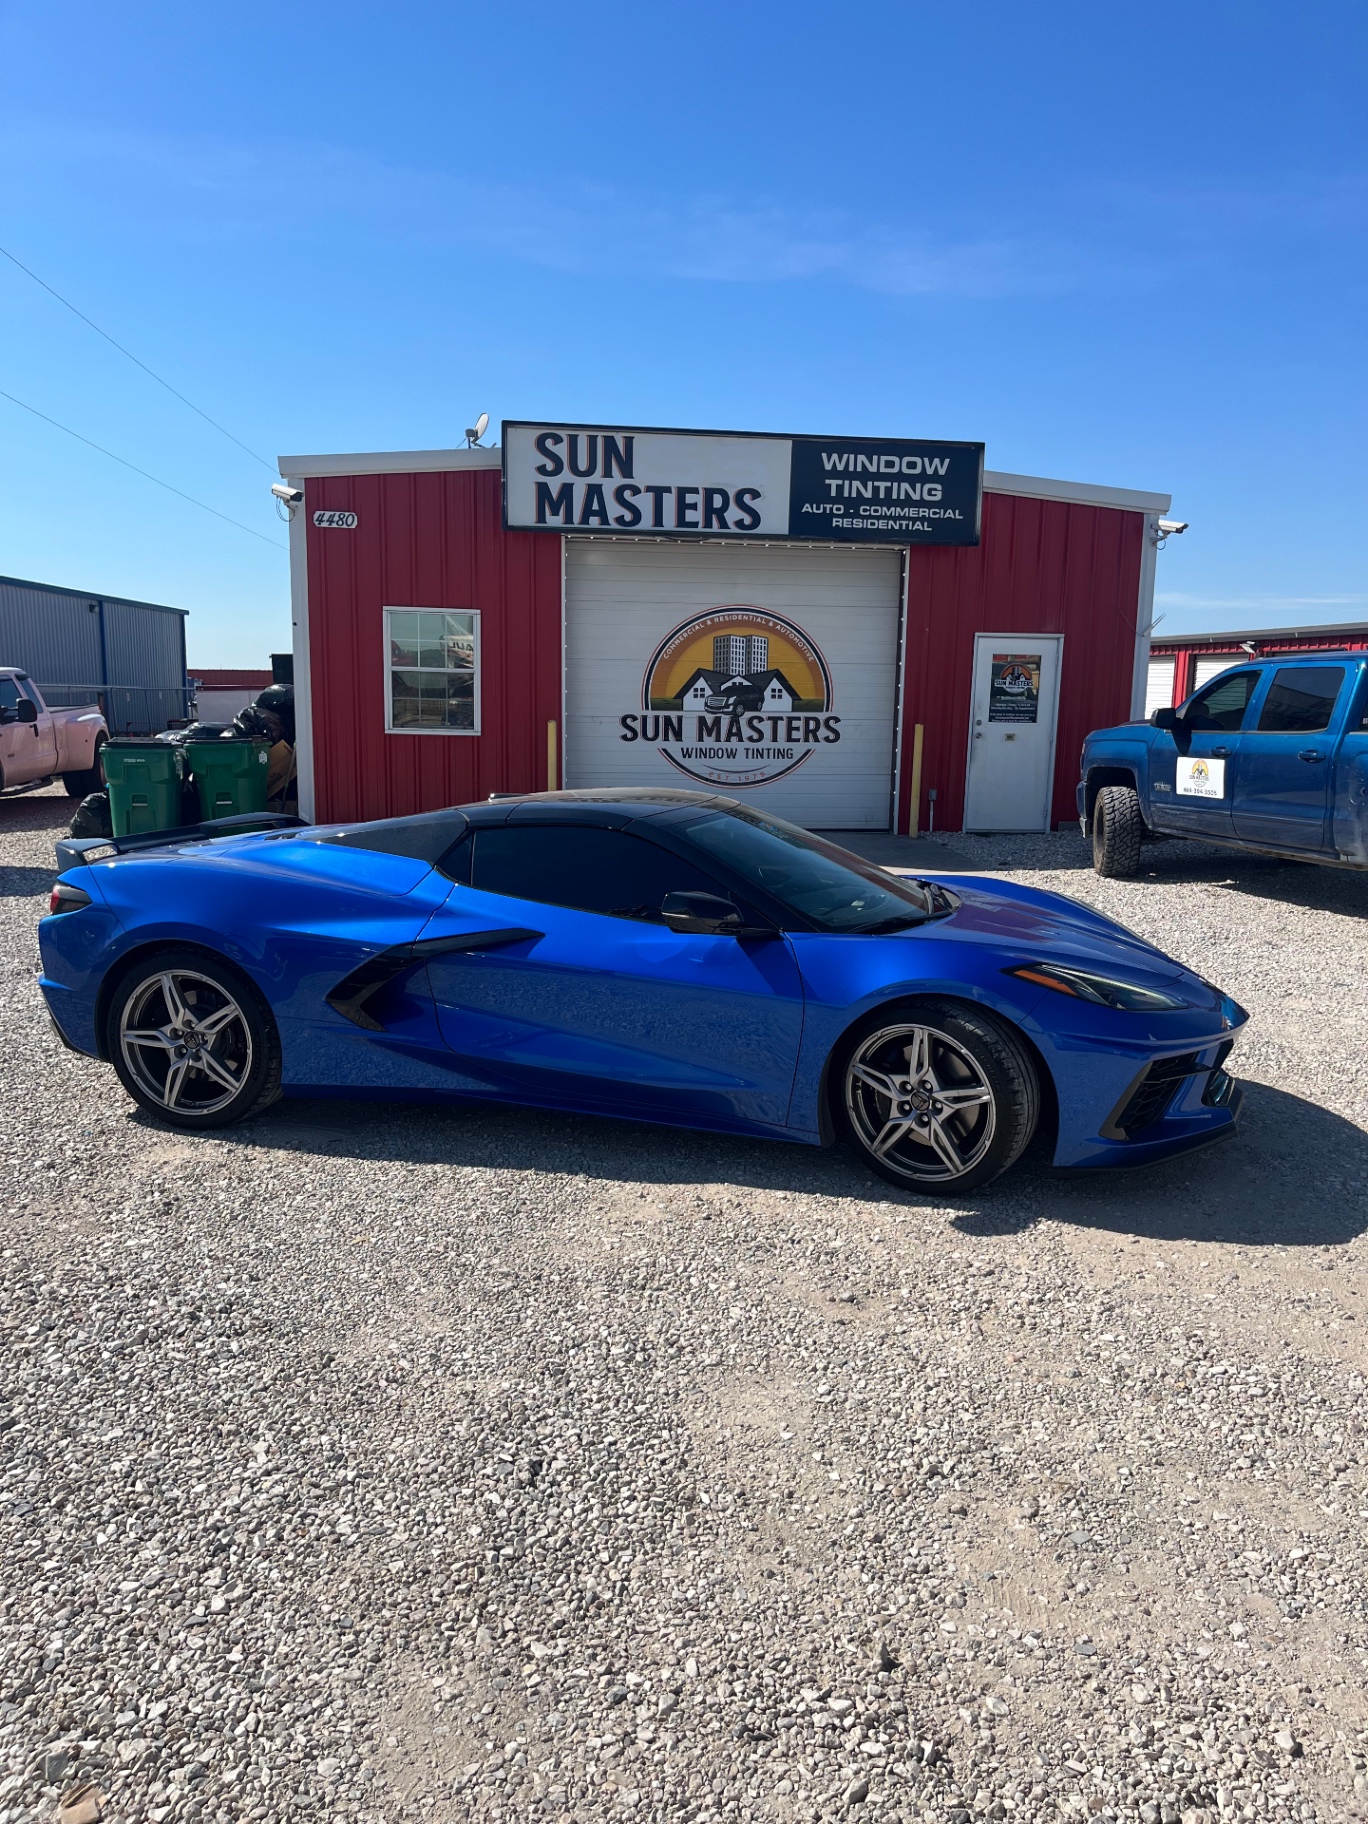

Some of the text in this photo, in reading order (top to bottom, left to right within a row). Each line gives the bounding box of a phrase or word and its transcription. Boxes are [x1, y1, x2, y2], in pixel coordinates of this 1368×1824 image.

[534, 432, 635, 479] SUN
[821, 452, 950, 476] WINDOW
[825, 479, 943, 501] TINTING
[534, 481, 762, 531] MASTERS
[801, 503, 844, 514] AUTO
[859, 506, 964, 519] COMMERCIAL
[315, 512, 355, 527] 4480
[832, 518, 933, 531] RESIDENTIAL
[663, 623, 705, 659] COMMERCIAL
[713, 614, 766, 624] RESIDENTIAL
[775, 624, 815, 662] AUTOMOTIVE
[619, 714, 841, 743] SUN MASTERS
[681, 747, 793, 760] WINDOW TINTING
[738, 771, 765, 781] 1979
